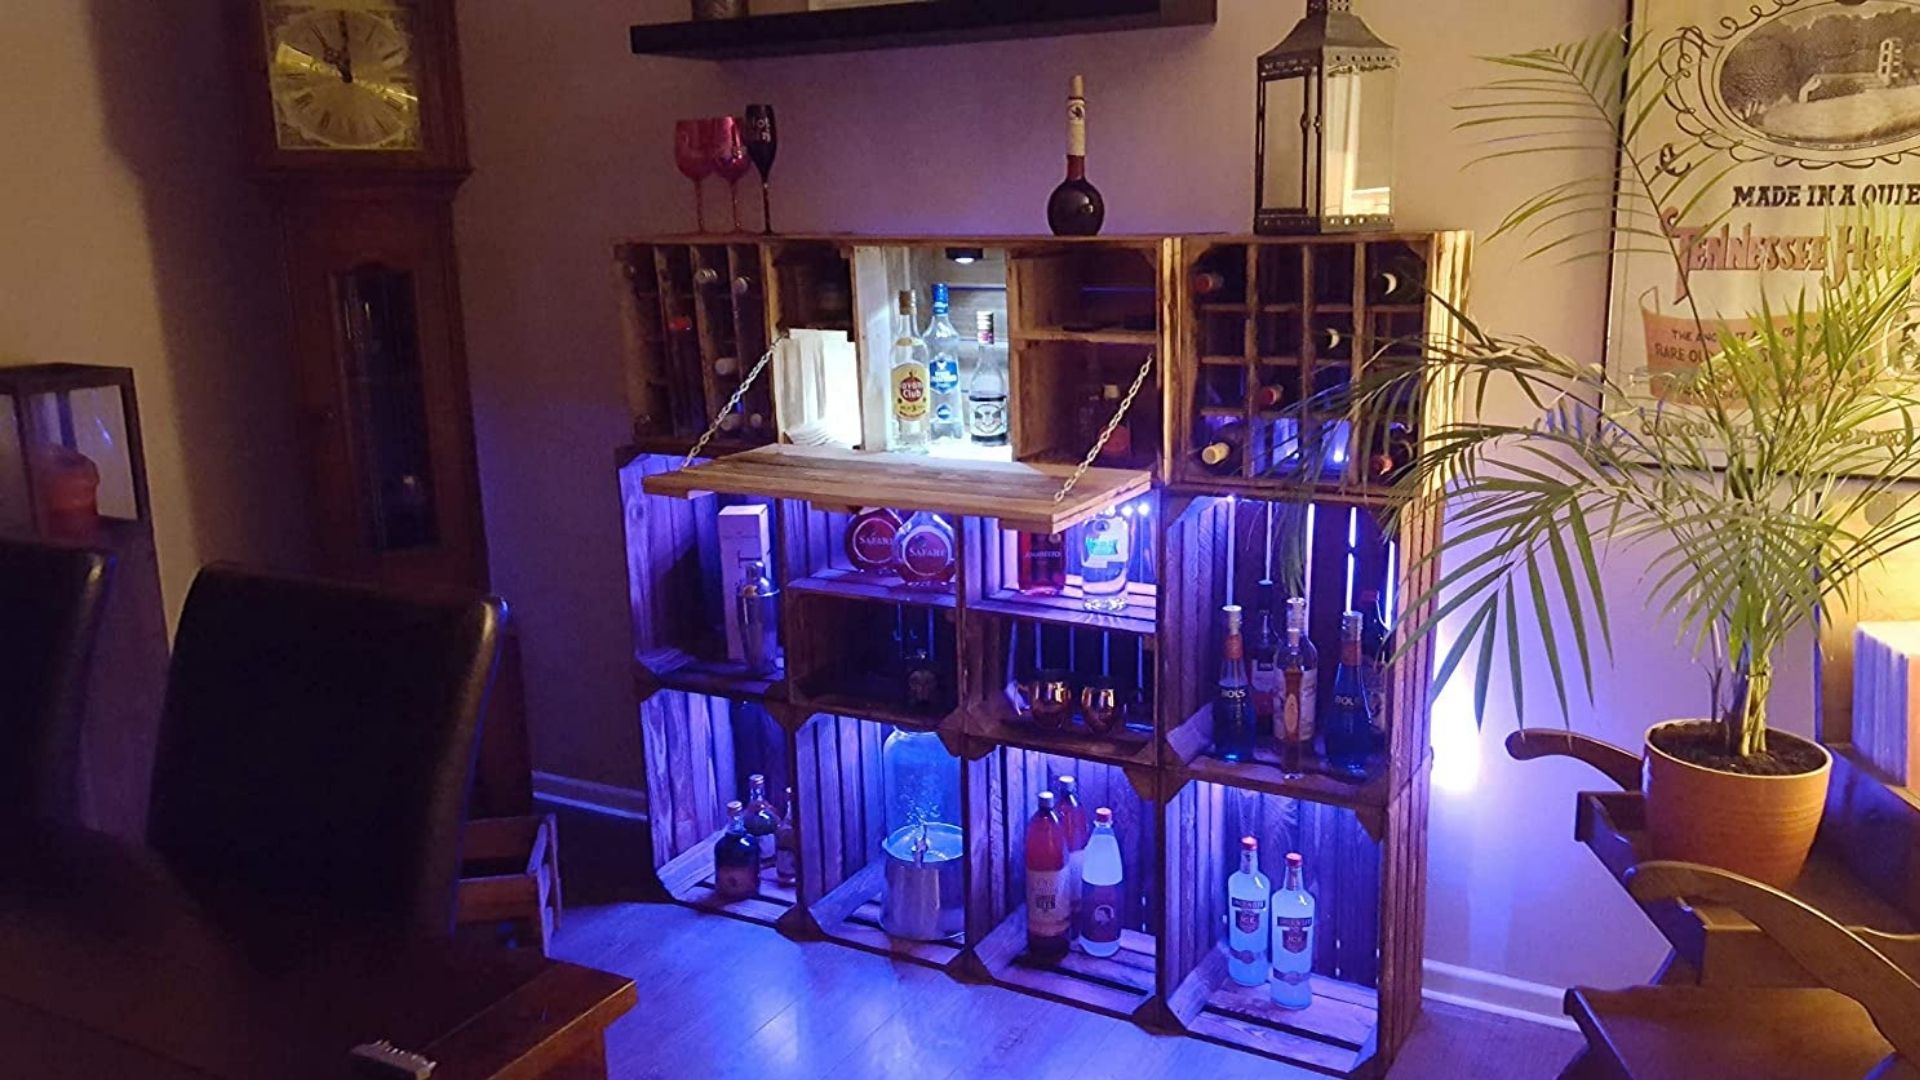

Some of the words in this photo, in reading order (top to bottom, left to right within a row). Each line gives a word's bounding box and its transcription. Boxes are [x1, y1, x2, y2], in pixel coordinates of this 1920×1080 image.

[1732, 185, 1800, 207] MADE
[1806, 185, 1834, 206] IN
[1838, 185, 1855, 206] A
[1672, 329, 1692, 341] THE
[1654, 342, 1685, 362] RARE
[908, 547, 945, 558] SAFARI
[1334, 695, 1359, 706] BOL
